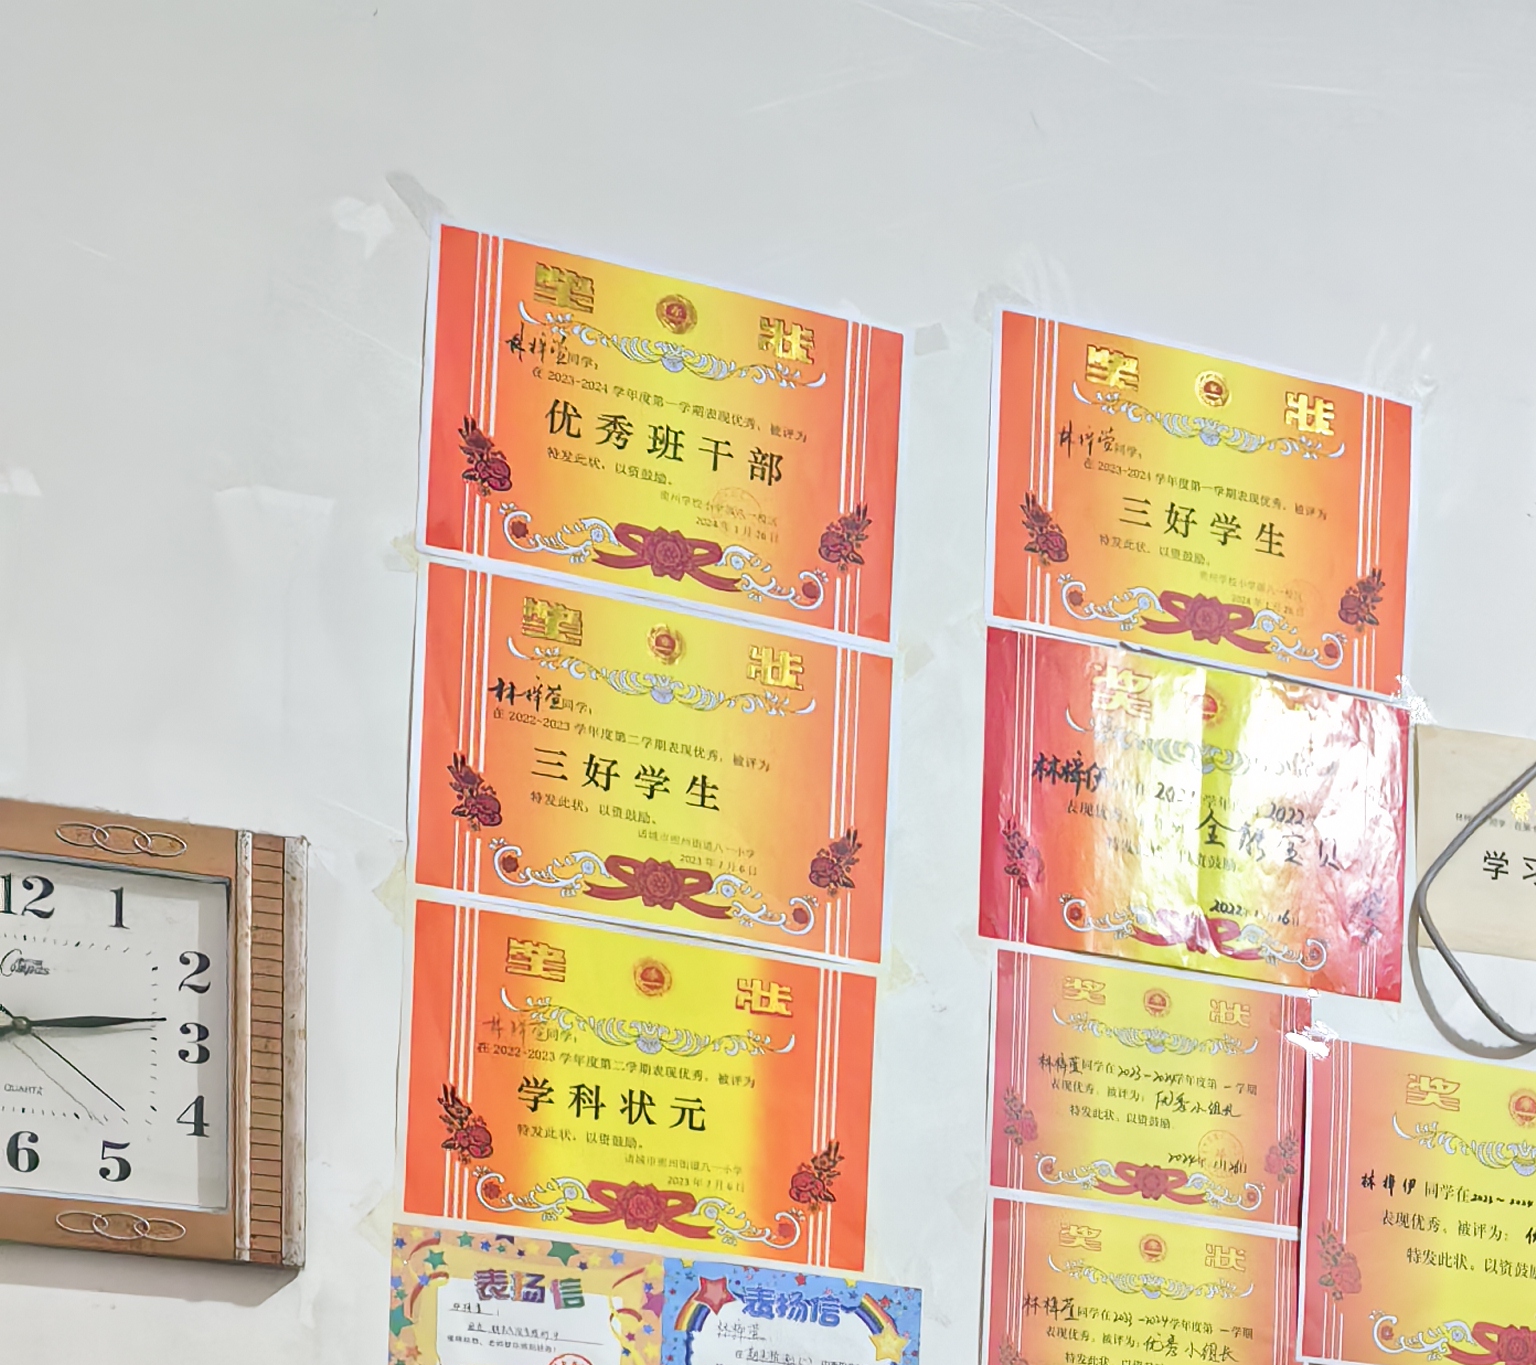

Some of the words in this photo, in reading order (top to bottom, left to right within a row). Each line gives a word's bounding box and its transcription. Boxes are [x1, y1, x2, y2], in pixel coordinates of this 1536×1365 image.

[545, 398, 784, 486] 优秀班干部
[1119, 496, 1286, 558] 三好学生
[531, 747, 721, 813] 三好学生
[109, 887, 130, 930] 1
[178, 951, 211, 994] 2
[178, 1022, 211, 1065] 3
[176, 1095, 210, 1138] 4
[517, 1074, 707, 1132] 学科状元
[6, 1130, 39, 1173] 6
[99, 1140, 132, 1182] 5
[473, 1268, 586, 1310] 表扬信
[742, 1286, 841, 1328] 表扬信
